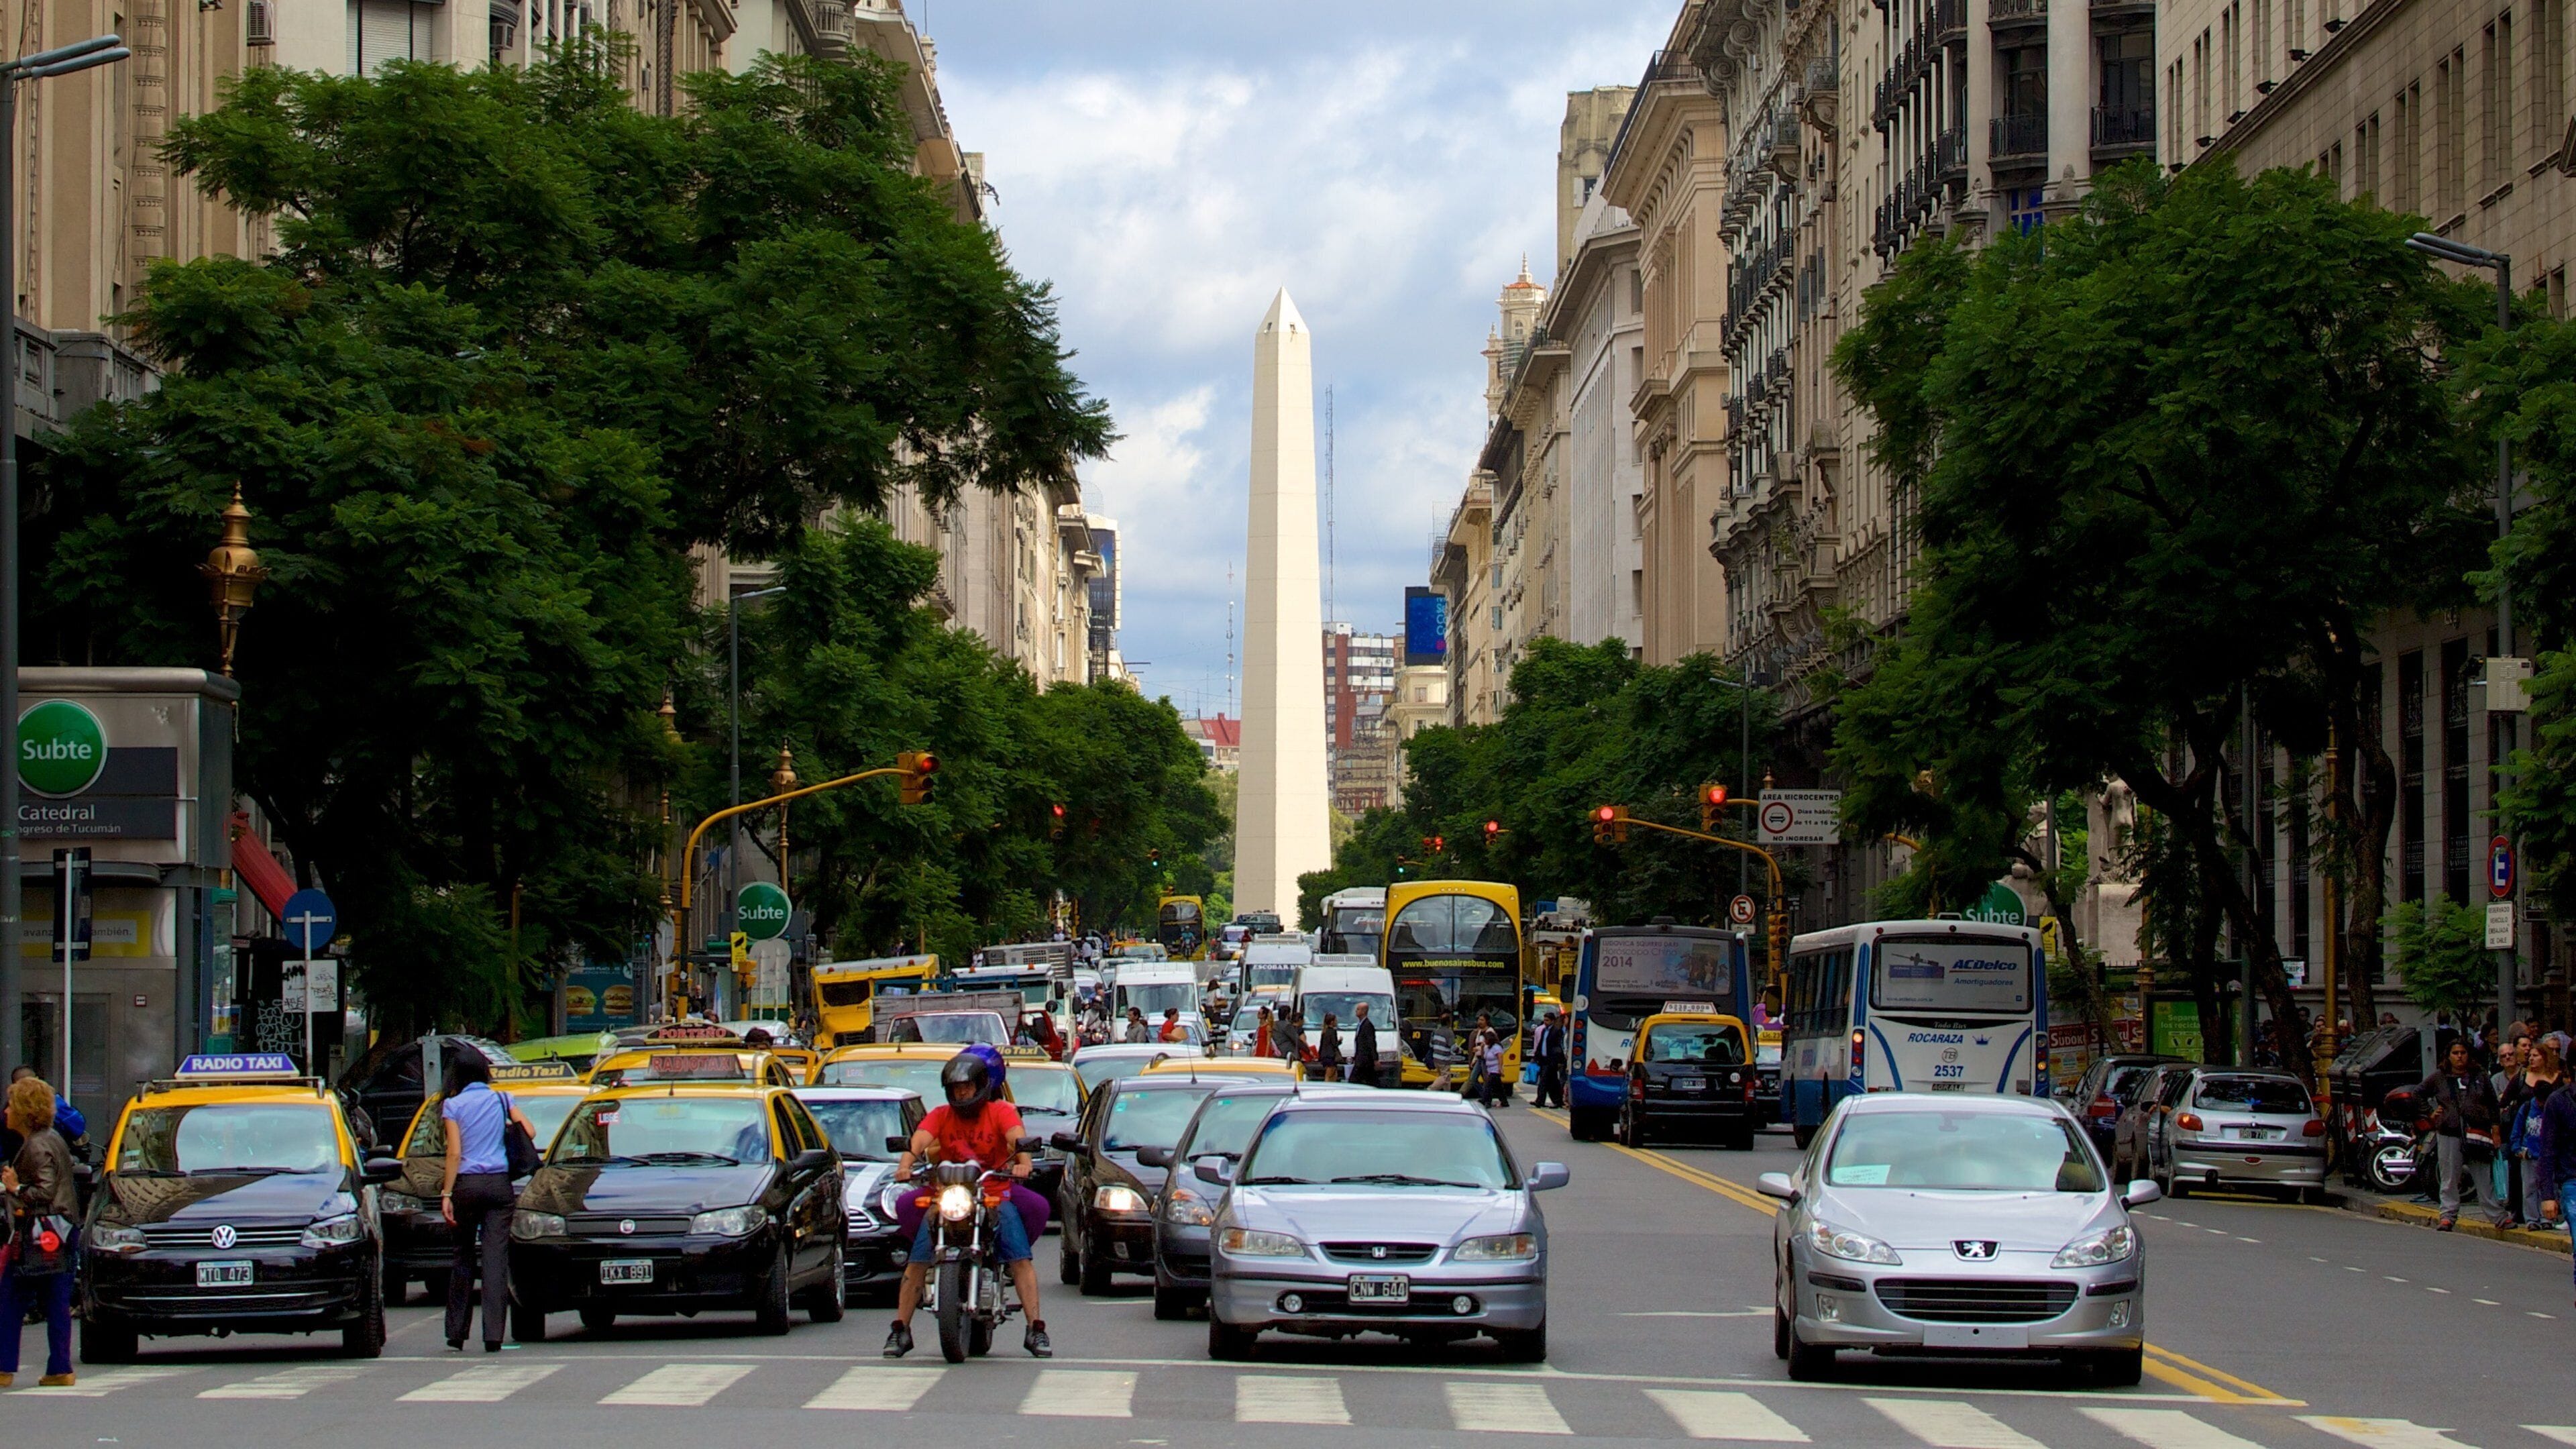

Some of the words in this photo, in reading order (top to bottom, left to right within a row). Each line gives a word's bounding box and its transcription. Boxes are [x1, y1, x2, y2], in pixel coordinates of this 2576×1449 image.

[22, 738, 92, 760] Subte
[17, 804, 95, 820] Catedral
[56, 824, 70, 833] de
[72, 824, 121, 834] Tucumán
[2494, 847, 2506, 886] E
[738, 904, 784, 920] Subte
[1966, 908, 2020, 924] Subte
[1401, 958, 1505, 969] www.buenosairesbus.com
[1602, 955, 1633, 967] 2014
[1952, 959, 2018, 971] ACDelco
[1953, 977, 2014, 987] Amortiguadores
[659, 1026, 727, 1039] PORTEÑO
[1907, 1032, 1964, 1044] ROCARAZA
[1013, 1046, 1038, 1055] Taxi
[192, 1057, 244, 1070] RADIO
[246, 1057, 283, 1069] TAXI
[489, 1066, 531, 1079] Radio
[531, 1065, 566, 1077] Taxi
[1934, 1065, 1964, 1077] 2537
[228, 1267, 250, 1281] 473
[603, 1266, 624, 1280] IKX
[630, 1265, 651, 1279] 891
[1352, 1282, 1375, 1296] CNW
[1383, 1282, 1405, 1296] 644
